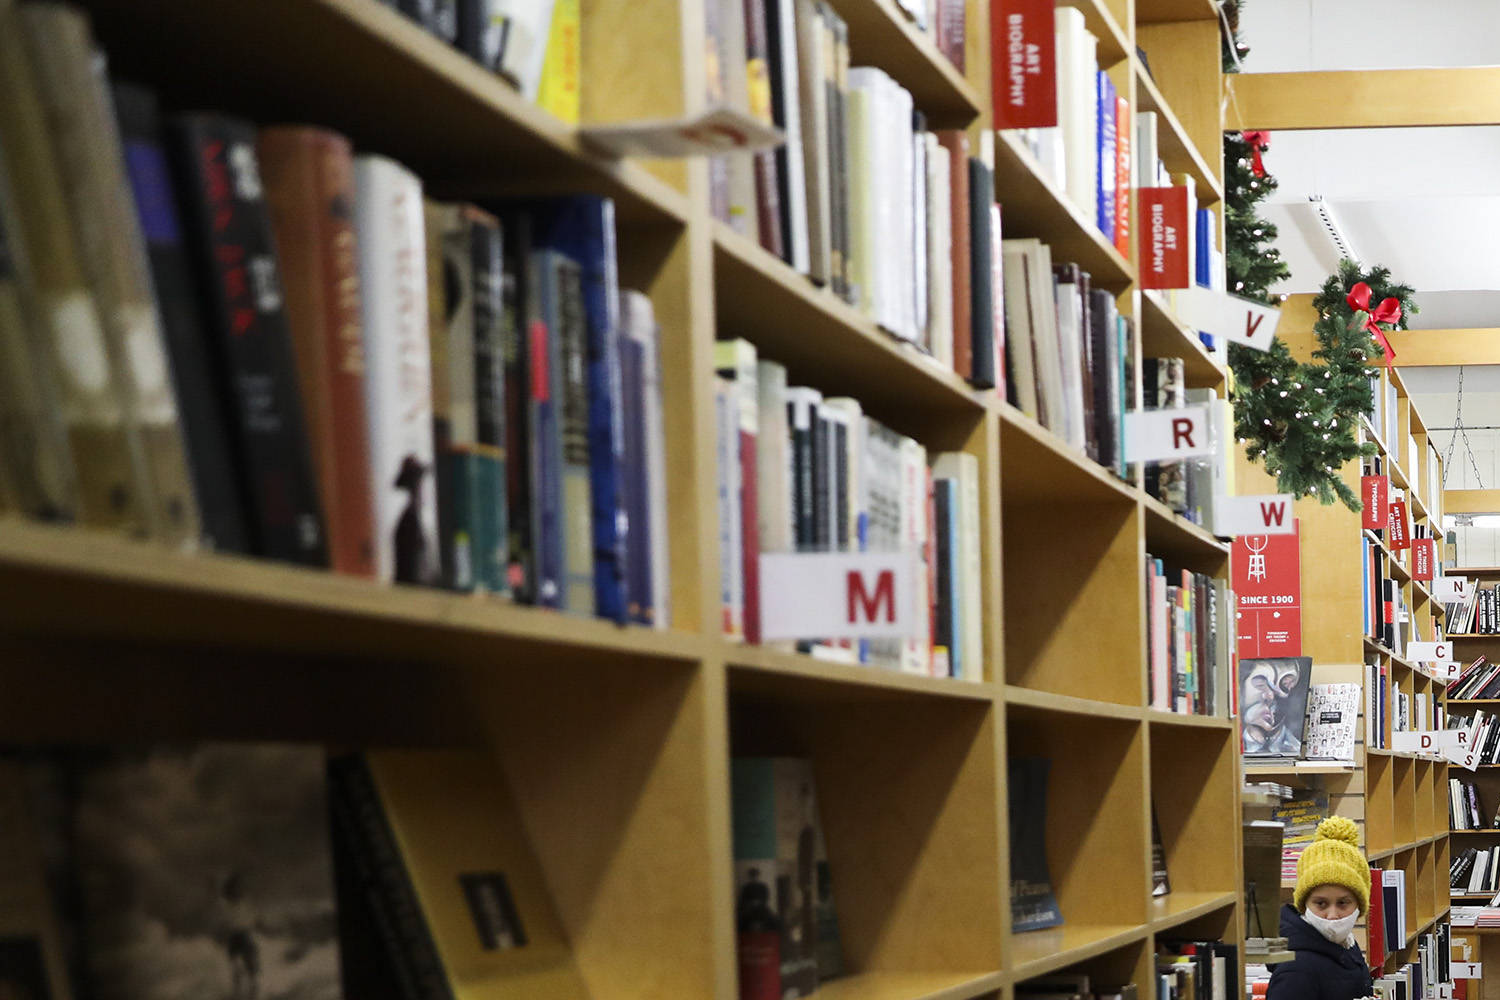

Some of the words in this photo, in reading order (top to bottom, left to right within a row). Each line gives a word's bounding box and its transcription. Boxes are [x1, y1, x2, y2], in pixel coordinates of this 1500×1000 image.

[1008, 14, 1024, 107] BIOGRAPHY
[1025, 43, 1040, 75] ART
[1151, 204, 1164, 274] BIOGRAPHY
[1165, 226, 1177, 250] ART
[1246, 311, 1264, 338] V
[1173, 418, 1194, 448] R
[1261, 502, 1284, 526] W
[1454, 581, 1462, 592] N
[847, 571, 895, 623] M
[1241, 596, 1268, 604] SINCE
[1271, 595, 1294, 604] 1900
[1436, 645, 1445, 659] C
[1448, 666, 1456, 675] P
[1421, 735, 1432, 748] D
[1458, 732, 1467, 743] R
[1464, 754, 1474, 767] S
[1468, 966, 1475, 975] T
[1439, 987, 1448, 999] L
